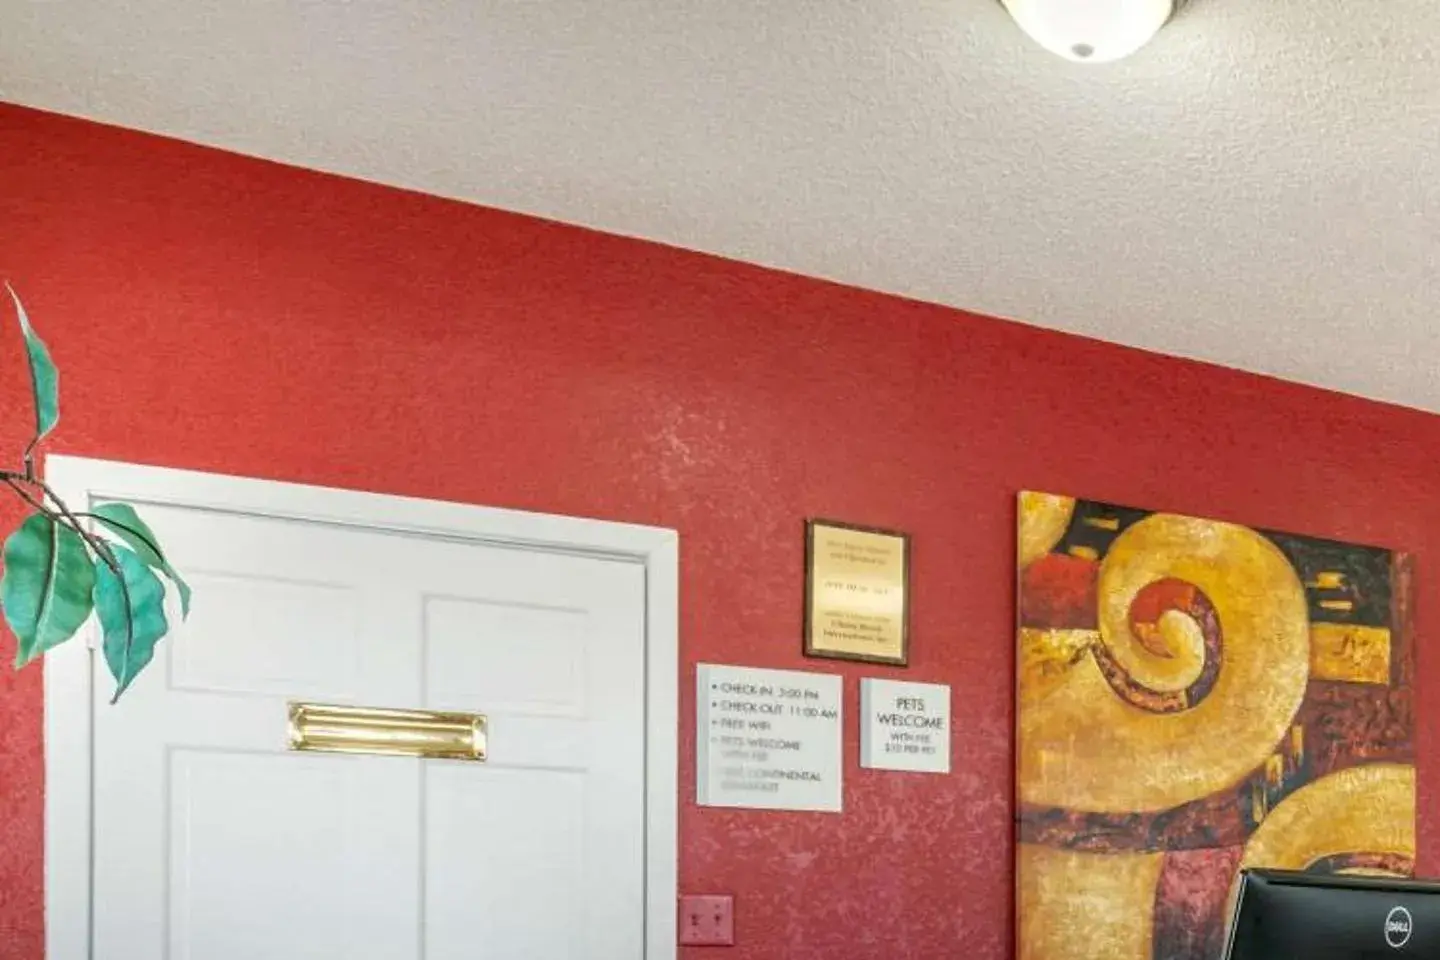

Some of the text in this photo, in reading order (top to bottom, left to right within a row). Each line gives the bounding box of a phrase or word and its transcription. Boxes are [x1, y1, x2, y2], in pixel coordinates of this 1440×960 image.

[895, 697, 925, 711] PETS
[876, 712, 945, 730] WELCOME
[748, 737, 801, 751] WELCOME
[1387, 920, 1409, 933] DELL
